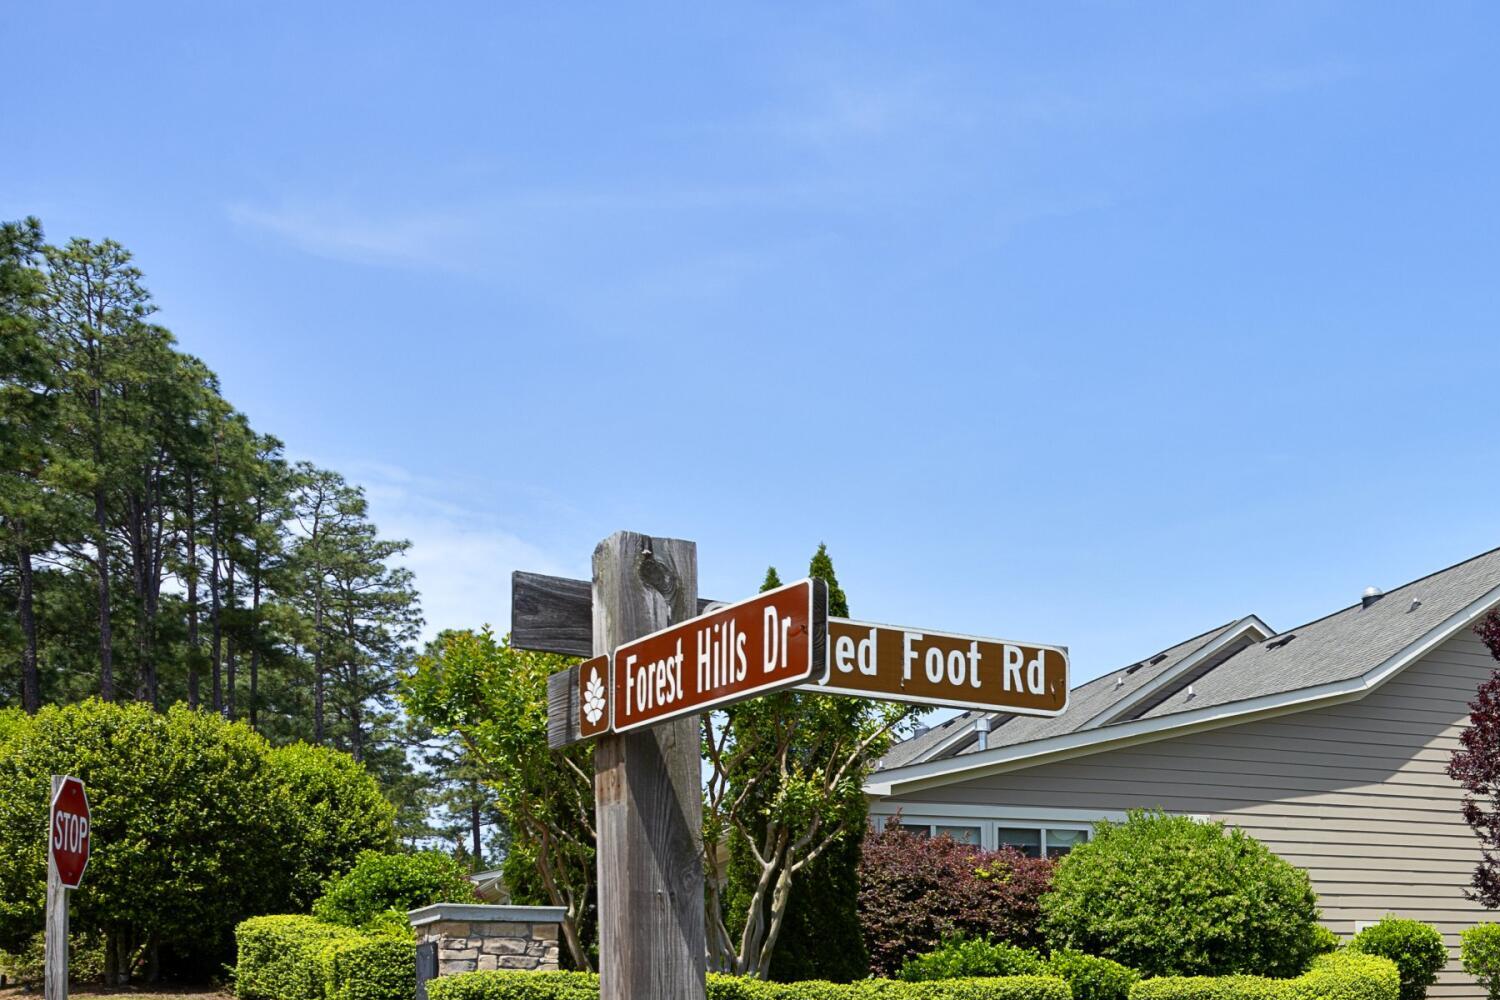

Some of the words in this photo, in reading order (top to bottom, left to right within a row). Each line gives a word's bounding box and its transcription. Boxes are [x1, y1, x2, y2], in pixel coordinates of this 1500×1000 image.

[626, 637, 683, 716] Forest
[697, 618, 747, 693] Hills
[763, 605, 791, 673] Dr
[903, 631, 981, 688] Foot
[1003, 644, 1044, 695] Rd
[54, 810, 88, 854] STOP
